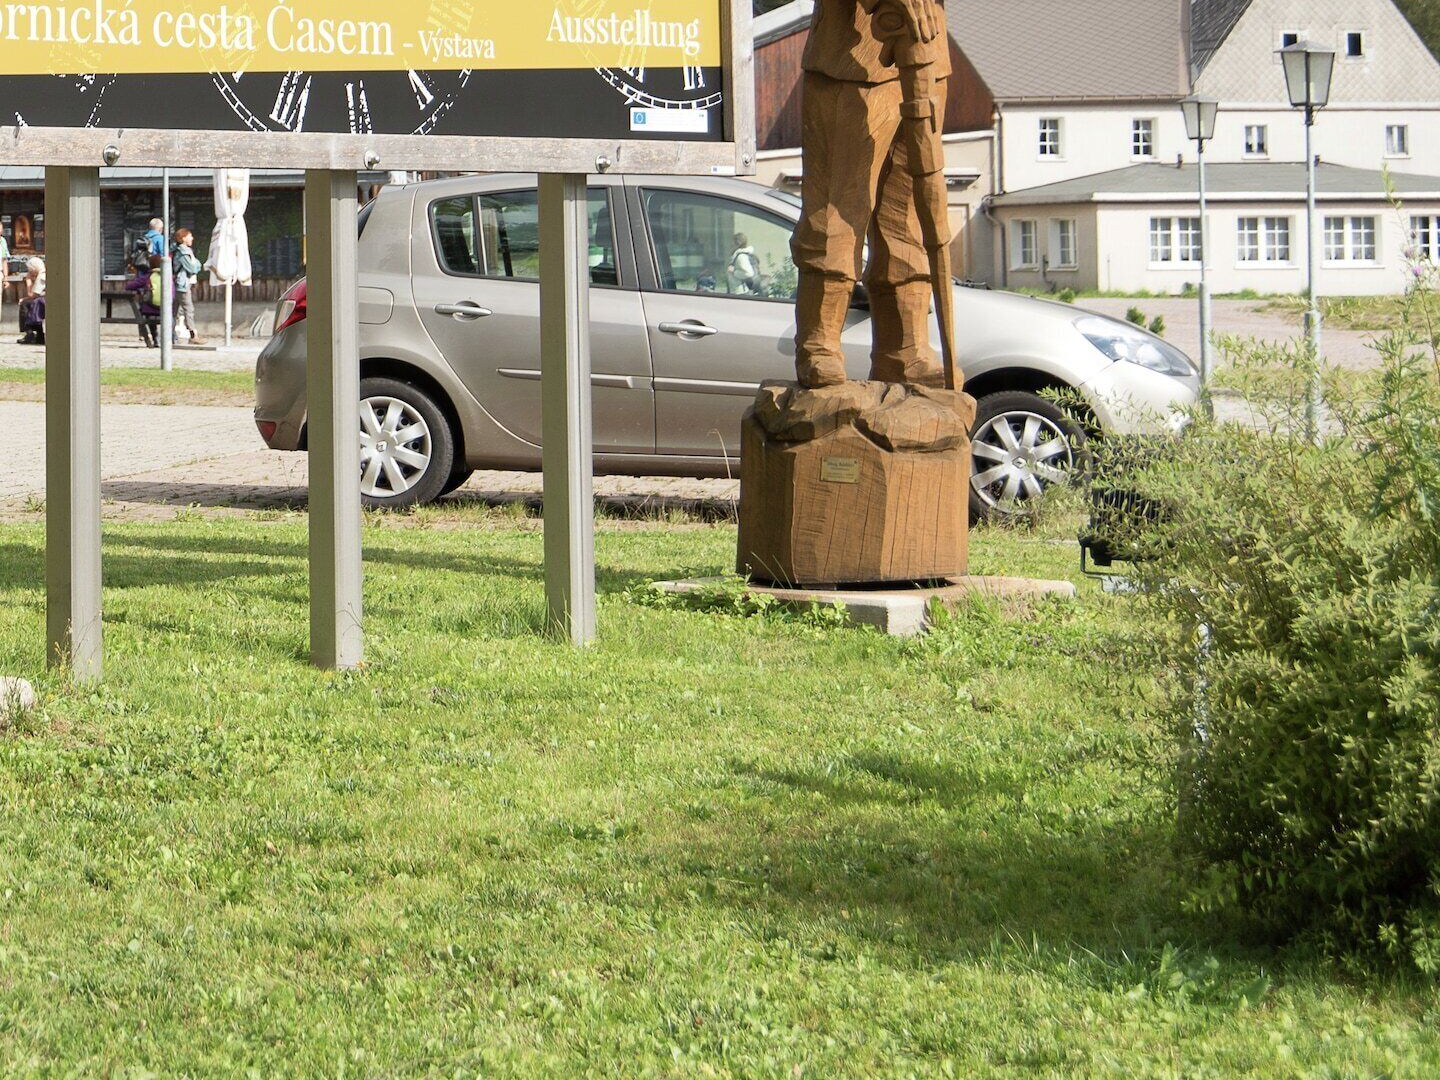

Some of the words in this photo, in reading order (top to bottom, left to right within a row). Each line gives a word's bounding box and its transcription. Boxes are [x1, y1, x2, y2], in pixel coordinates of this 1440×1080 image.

[153, 5, 256, 52] cesta
[417, 27, 496, 63] Výstava
[545, 7, 701, 57] Ausstellung
